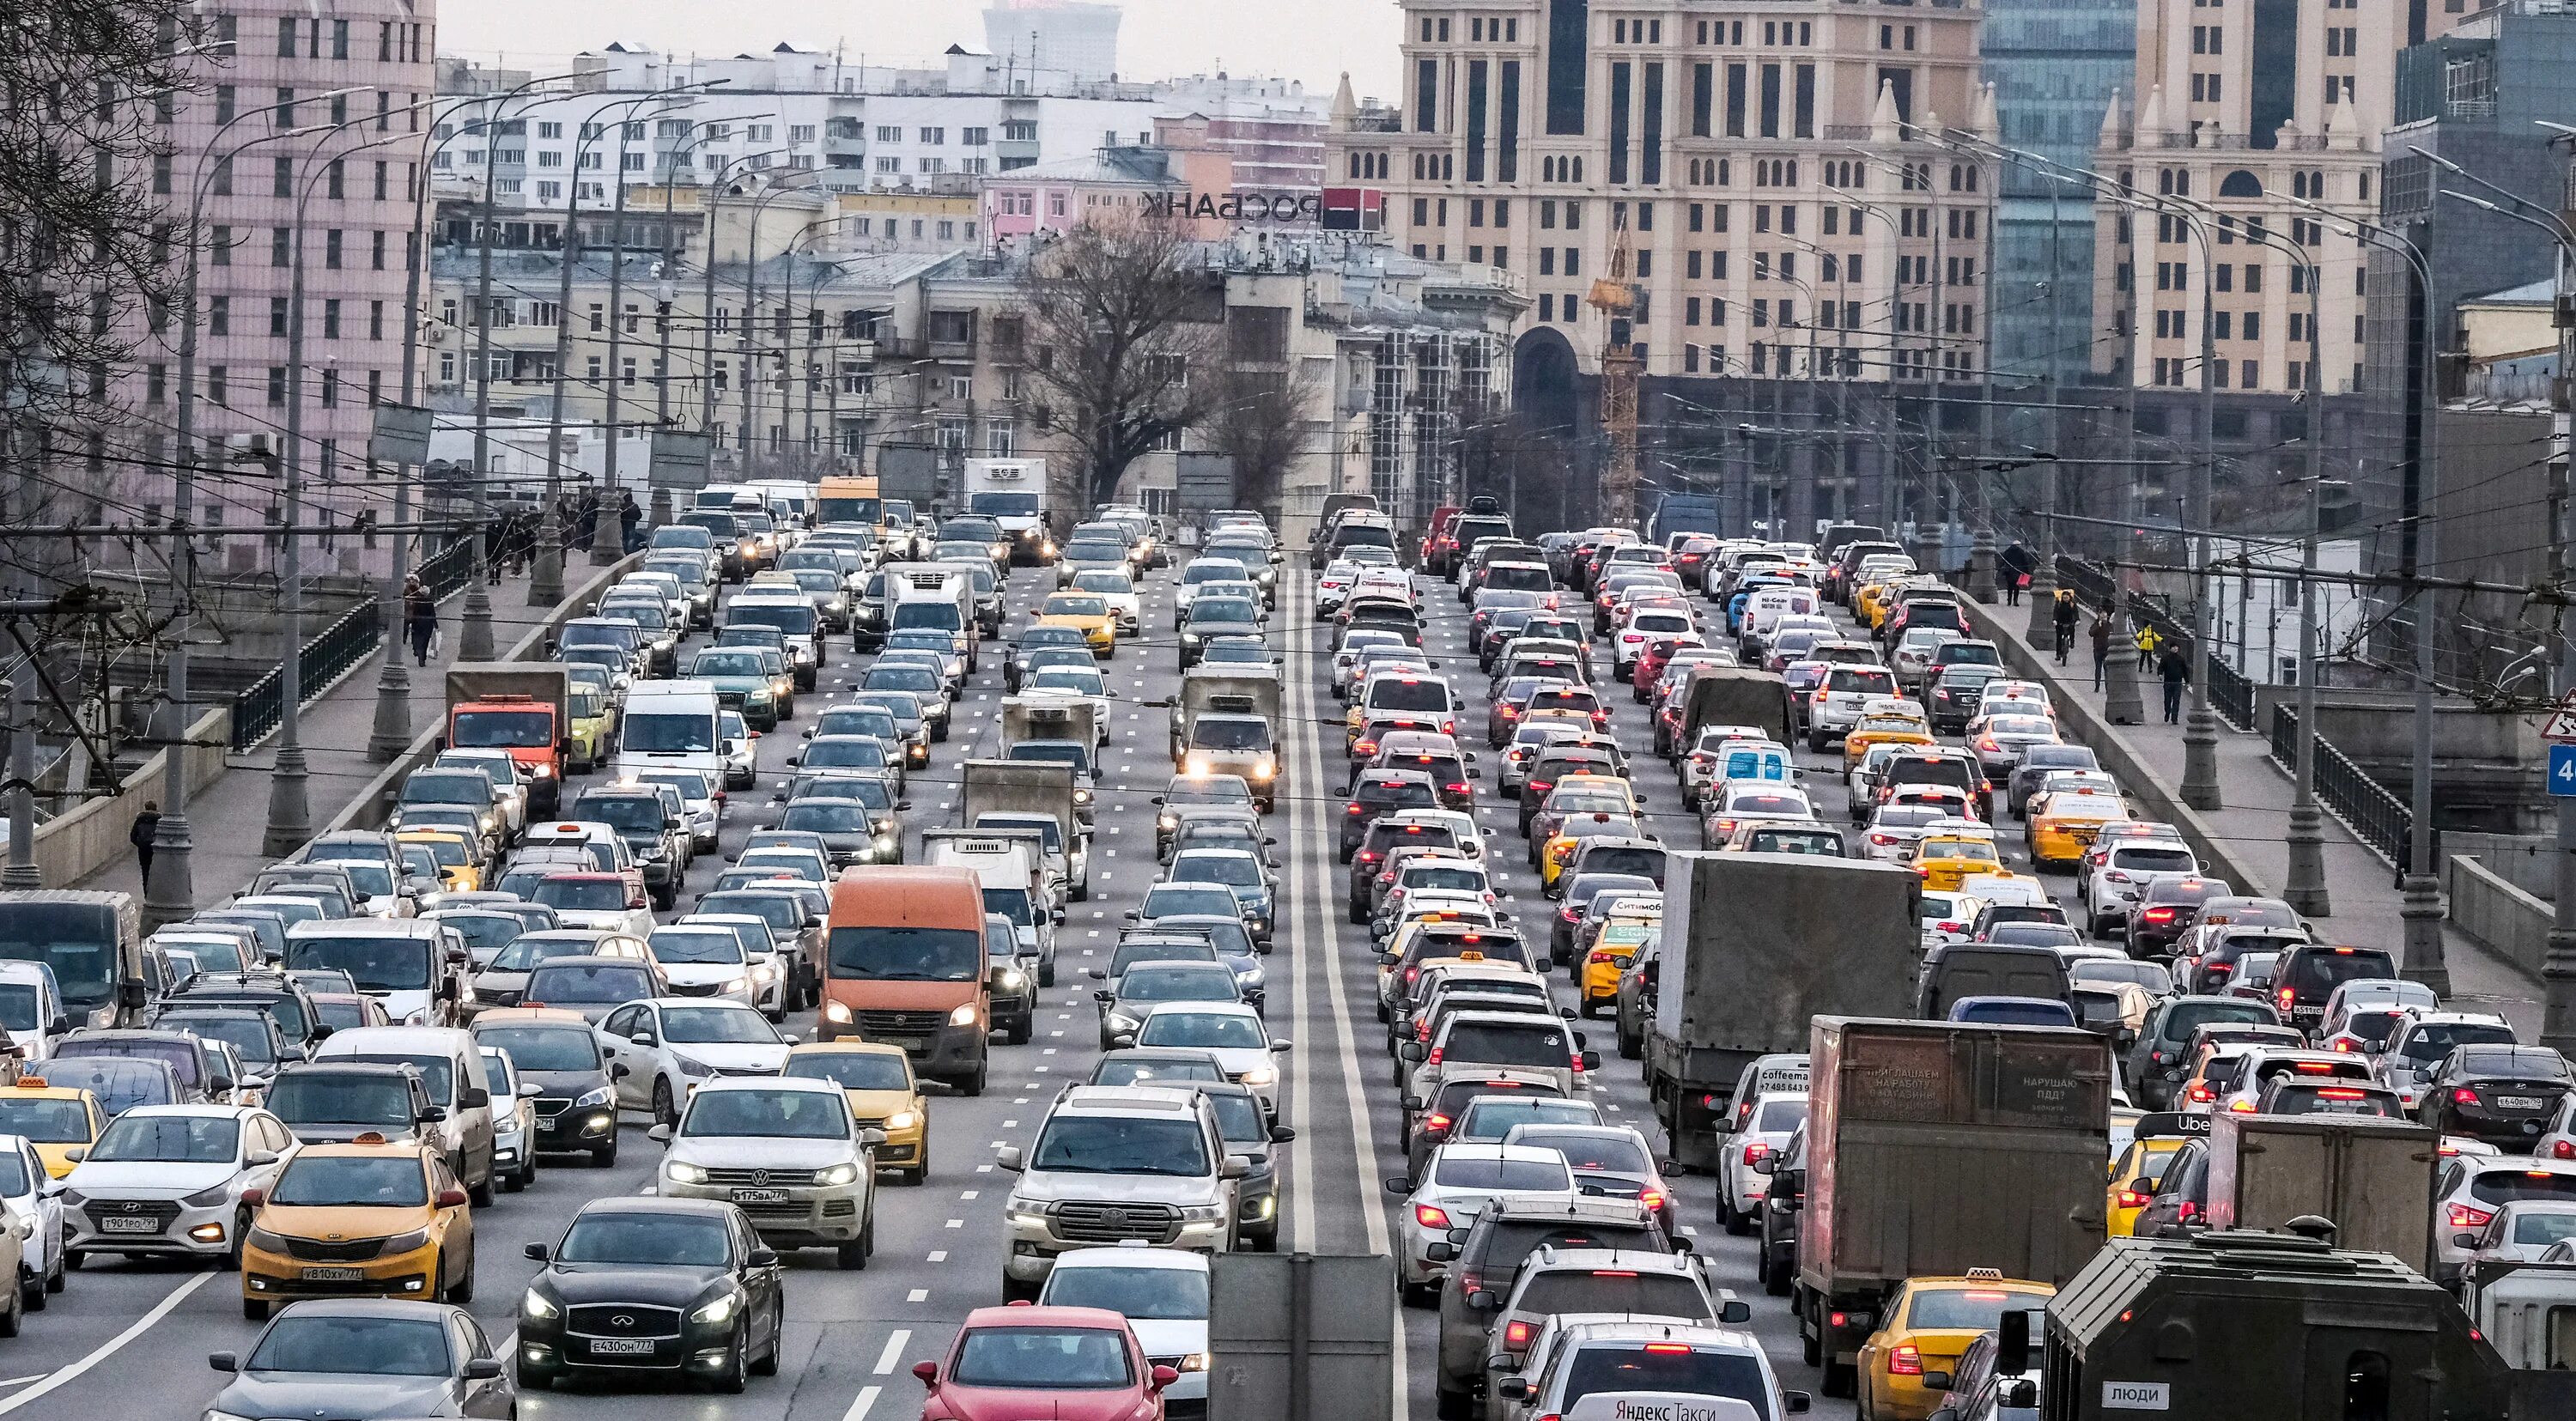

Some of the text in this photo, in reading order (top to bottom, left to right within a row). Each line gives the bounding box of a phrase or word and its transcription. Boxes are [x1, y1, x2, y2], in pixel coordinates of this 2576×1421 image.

[2558, 760, 2576, 781] 4
[1617, 902, 1662, 911] Ситимоб
[1762, 1071, 1808, 1080] coffeema
[1867, 1068, 1940, 1079] ПРИГЛАШАЕМ
[1760, 1083, 1770, 1091] +7
[1876, 1078, 1930, 1090] НА РАБОТУ
[2023, 1078, 2078, 1089] НАРУШАЮ
[1878, 1090, 1936, 1101] МАГАЗИНЫ
[2037, 1090, 2065, 1101] ПДД?
[2178, 1115, 2210, 1131] Ube
[2111, 1388, 2159, 1403] ЛЮДИ
[1615, 1400, 1716, 1421] Яндекс Такси
